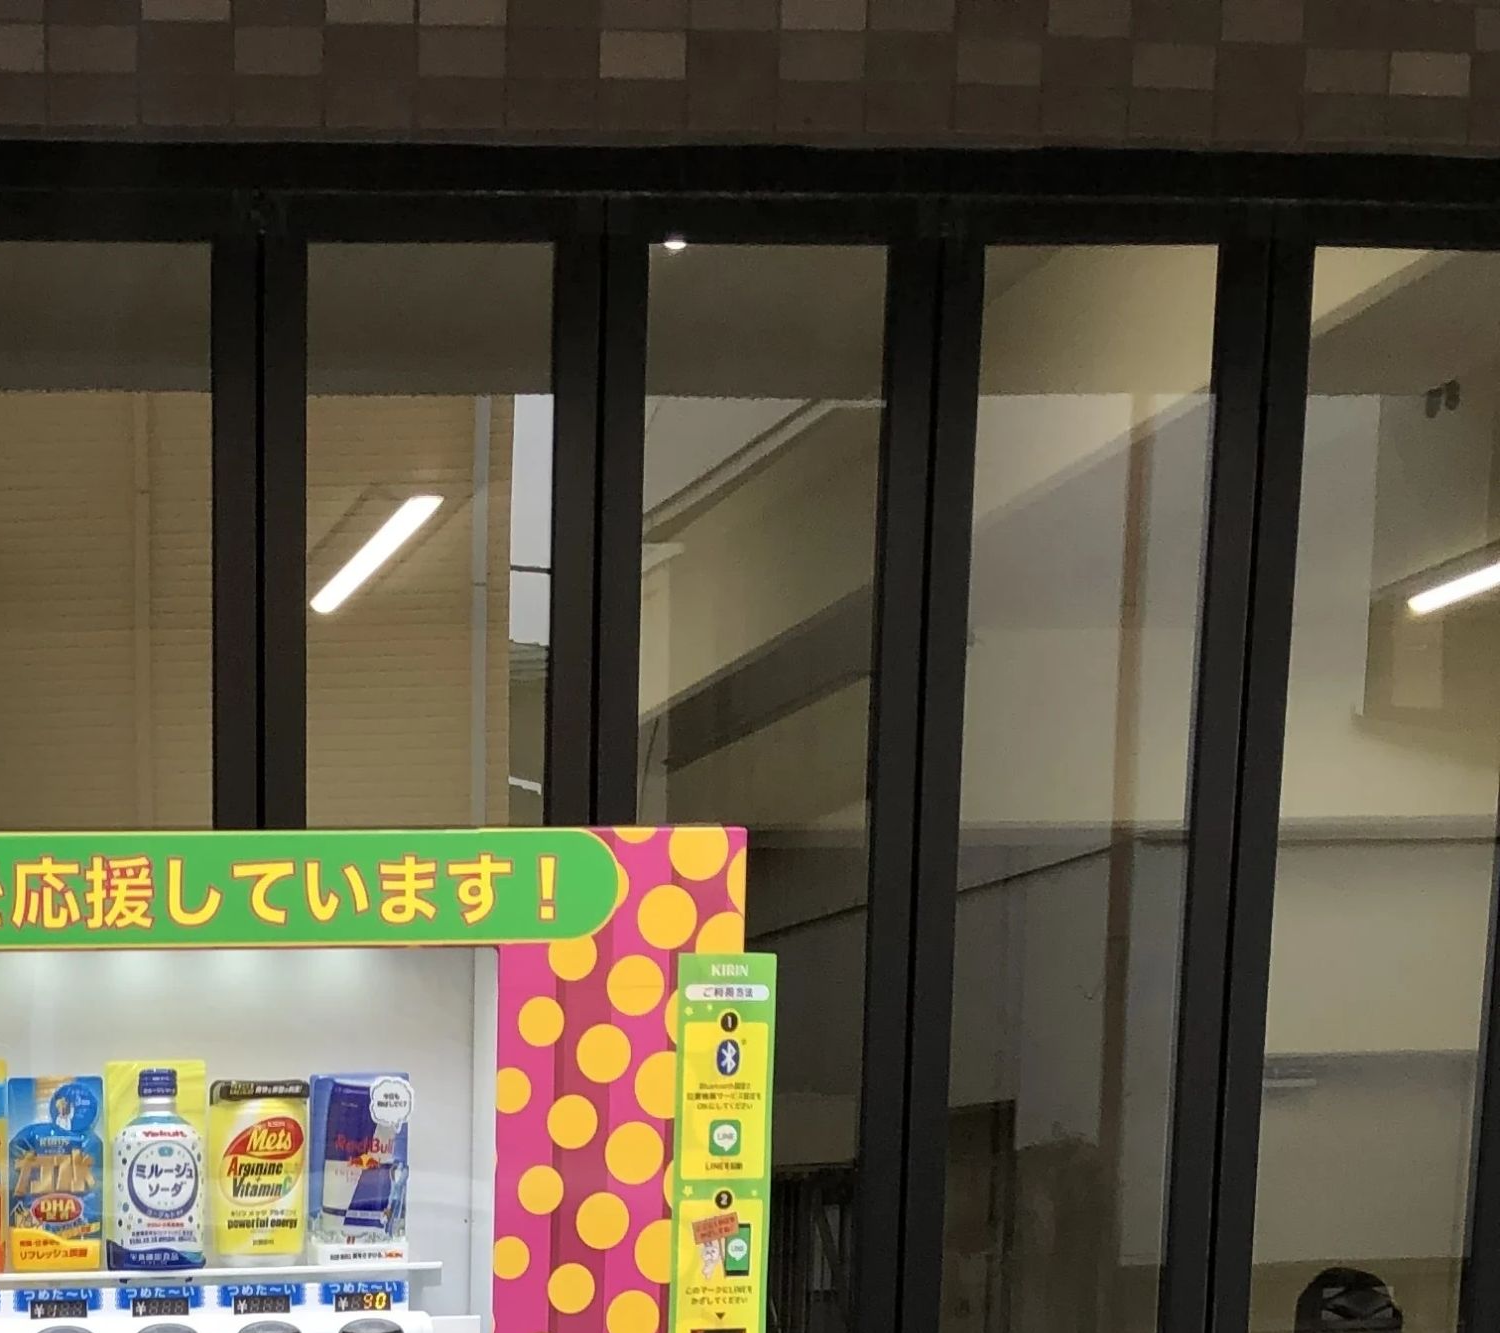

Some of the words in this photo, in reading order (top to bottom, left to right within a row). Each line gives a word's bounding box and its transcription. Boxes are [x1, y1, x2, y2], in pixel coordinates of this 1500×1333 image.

[711, 964, 749, 977] KIRIN
[703, 987, 753, 998] ご利用方法
[727, 1016, 732, 1028] 1
[248, 1128, 292, 1150] Mets
[135, 1163, 194, 1180] ミルージュ
[228, 1157, 283, 1176] Arginine
[149, 1182, 185, 1197] ソーダ
[721, 1193, 727, 1205] 2
[228, 1218, 268, 1230] powerful
[270, 1217, 298, 1229] energy
